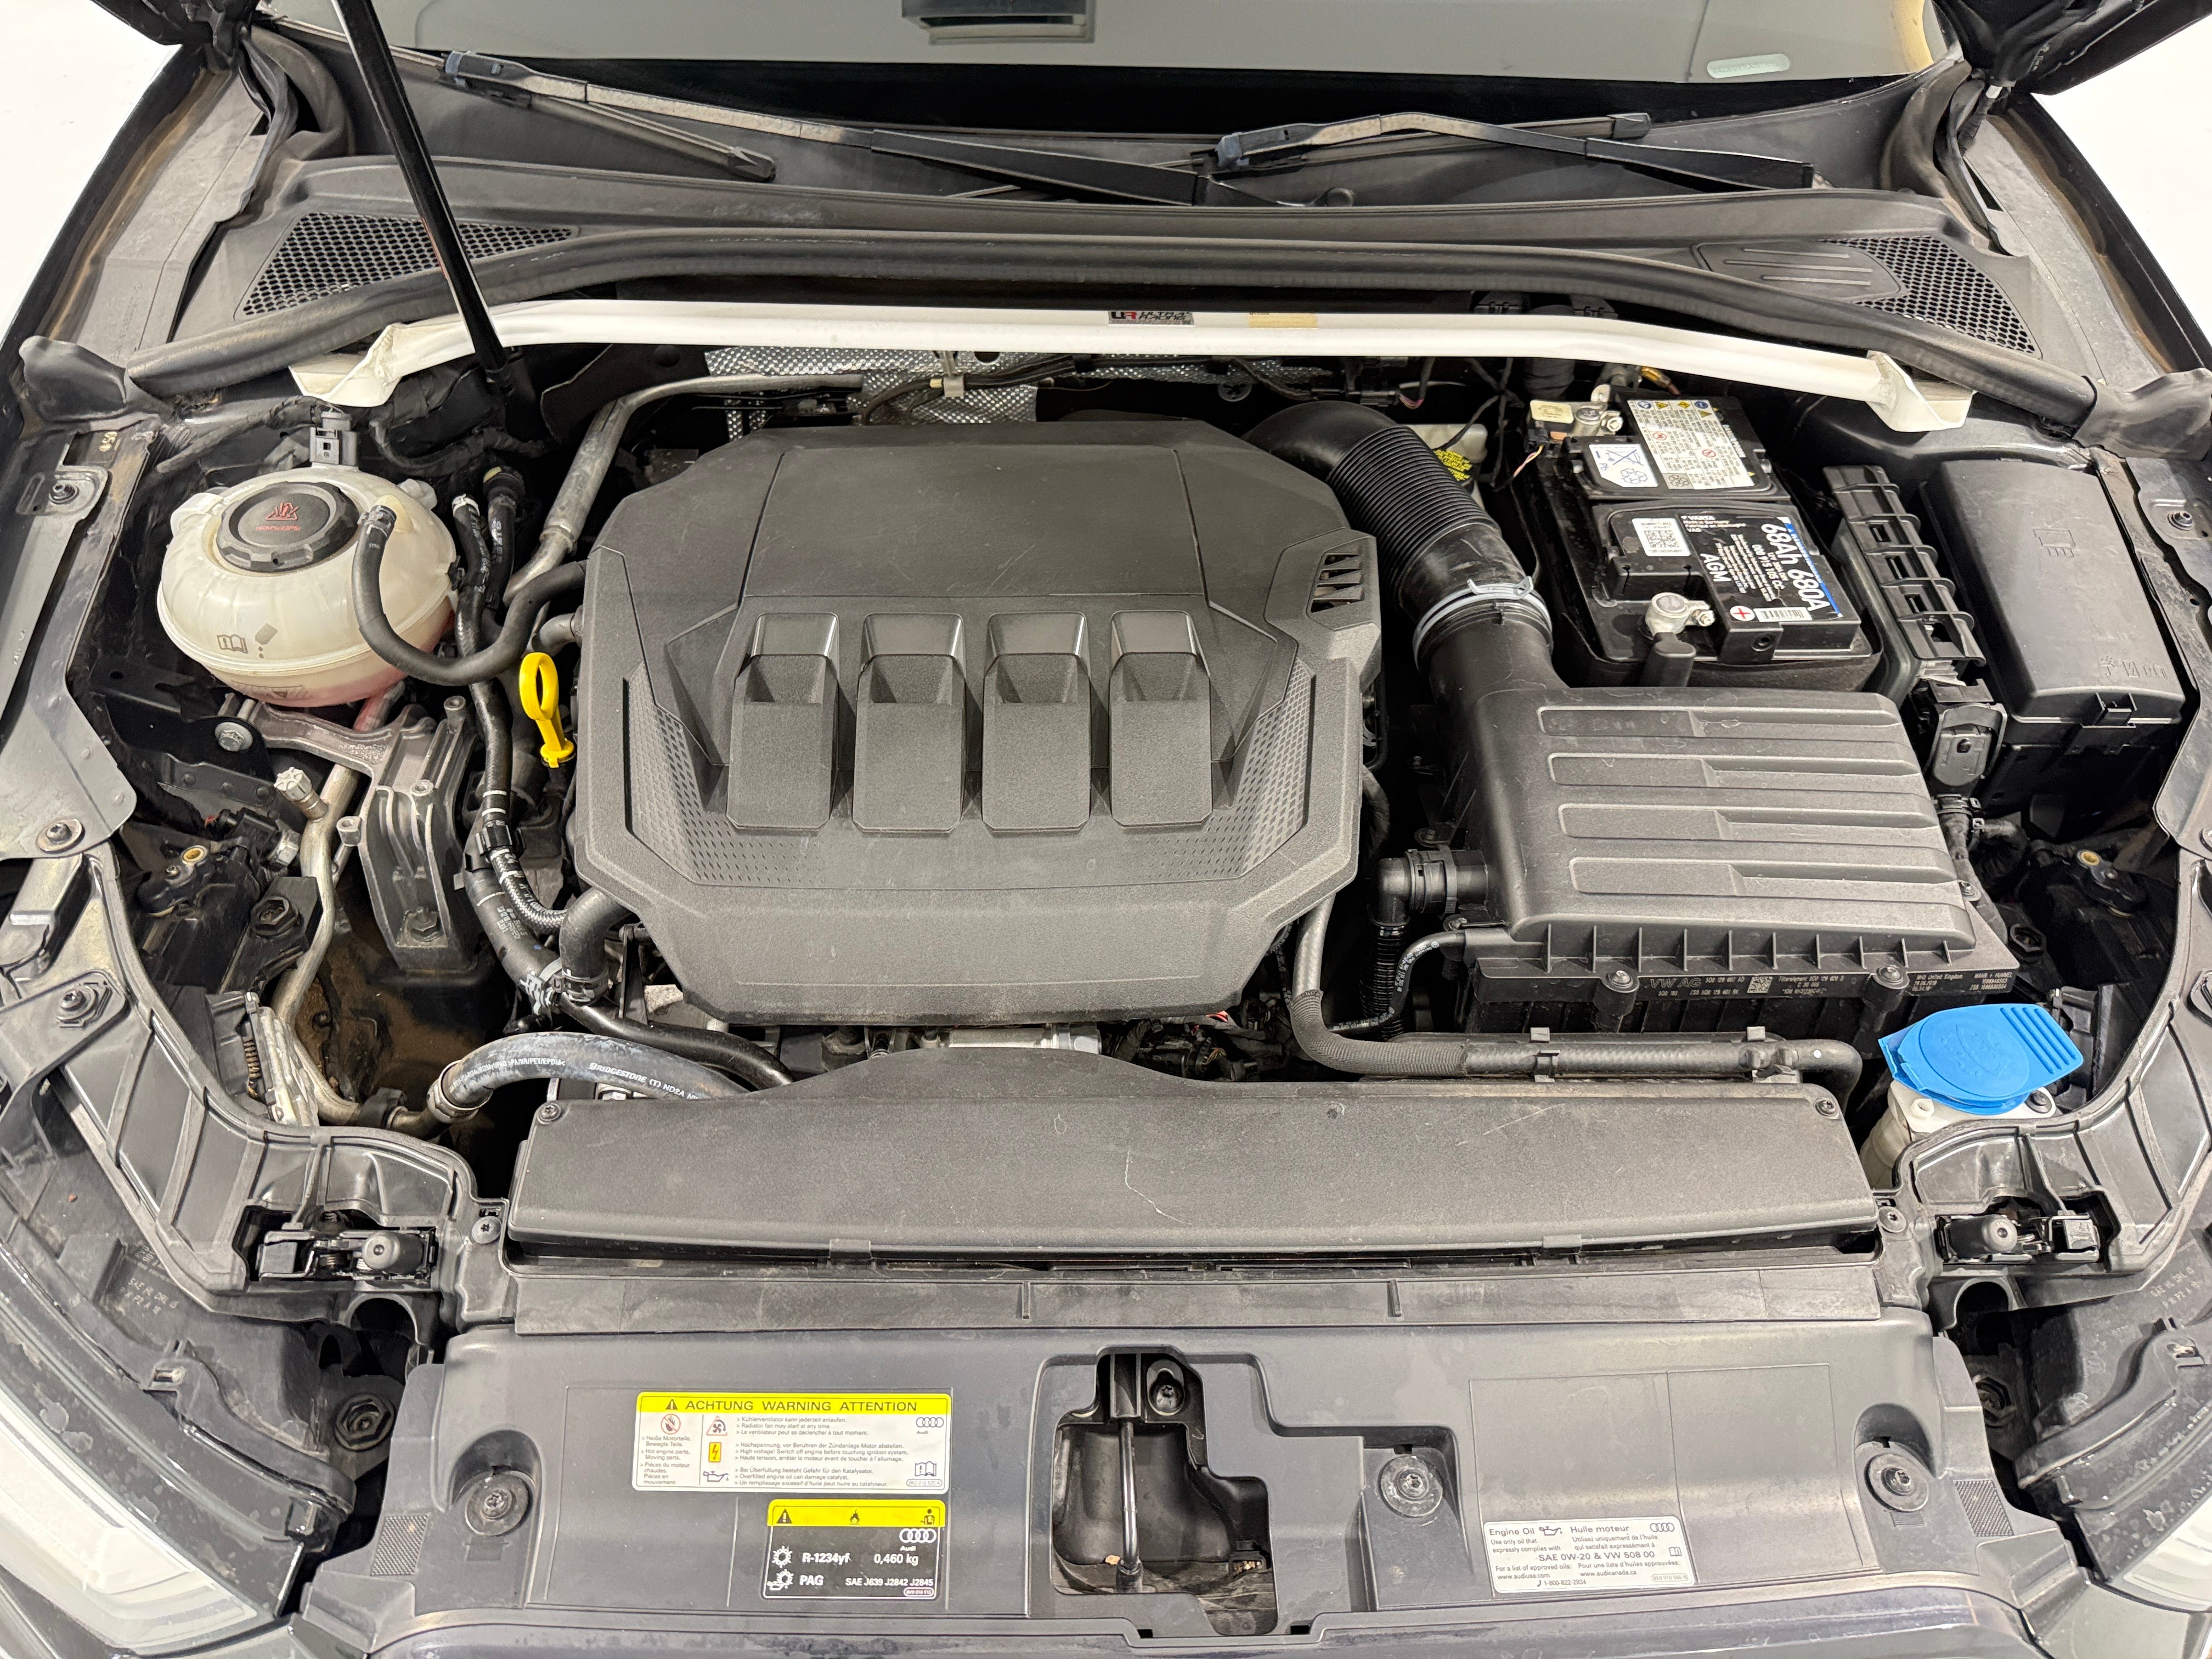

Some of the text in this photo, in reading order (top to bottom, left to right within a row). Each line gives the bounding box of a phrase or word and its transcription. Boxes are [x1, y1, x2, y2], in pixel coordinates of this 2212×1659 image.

[1700, 553, 1732, 582] AGM
[1752, 544, 1785, 590] 000 915 105 CC
[1761, 523, 1802, 565] 68Ah
[1787, 569, 1830, 612] 680A
[1650, 978, 1701, 988] VW AG
[588, 1062, 647, 1083] BRIDGESTONE
[649, 1079, 662, 1088] (T)
[663, 1084, 685, 1097] ND2A
[685, 1400, 917, 1412] ACHTUNG WARNING ATTENTION
[1489, 1528, 1520, 1537] Engine
[802, 1552, 919, 1566] R-1234yf 0,460 kg
[799, 1575, 823, 1586] PAG
[865, 1578, 883, 1586] J639
[884, 1578, 909, 1586] J2842
